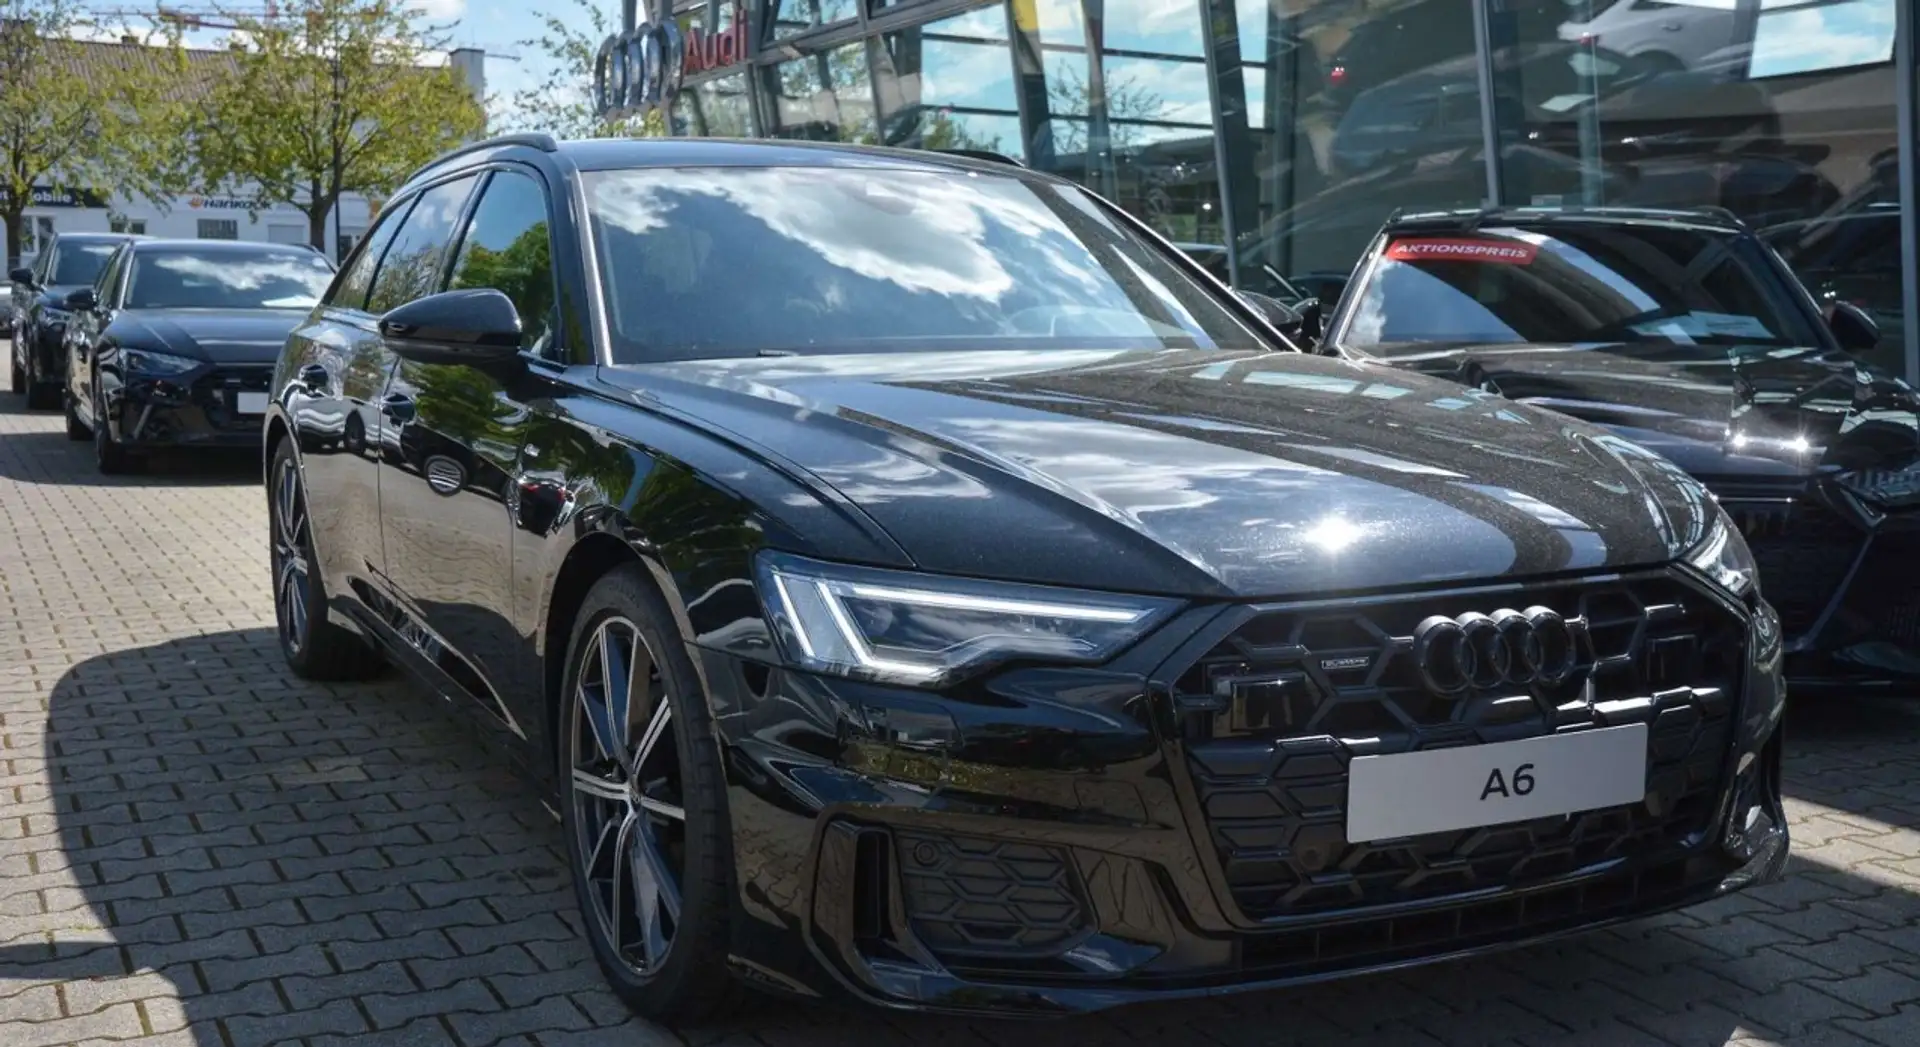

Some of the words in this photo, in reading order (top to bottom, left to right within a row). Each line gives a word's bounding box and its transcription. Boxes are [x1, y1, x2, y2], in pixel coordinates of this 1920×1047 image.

[683, 8, 748, 75] Audi
[1395, 243, 1529, 258] AKTIONSPREIS
[1480, 762, 1535, 801] A6
